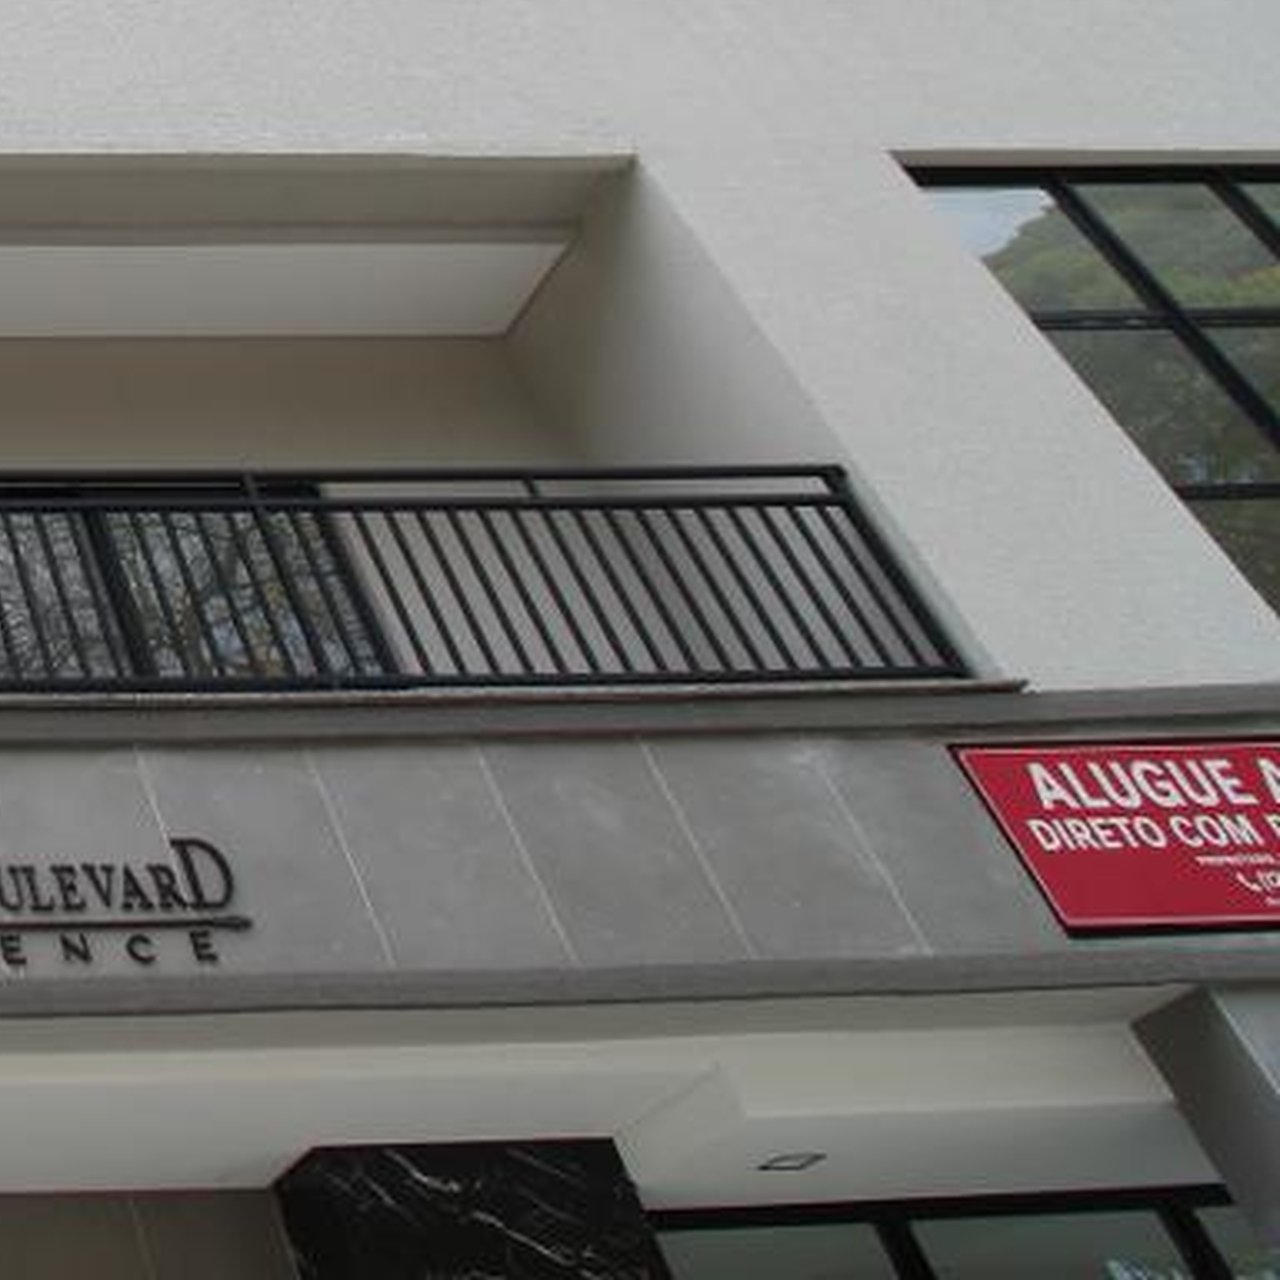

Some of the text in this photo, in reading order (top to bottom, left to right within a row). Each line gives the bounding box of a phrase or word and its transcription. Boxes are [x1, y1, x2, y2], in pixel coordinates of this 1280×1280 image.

[1028, 758, 1258, 809] ALUGUE
[1028, 816, 1168, 851] DIRETO
[1169, 813, 1265, 848] COM
